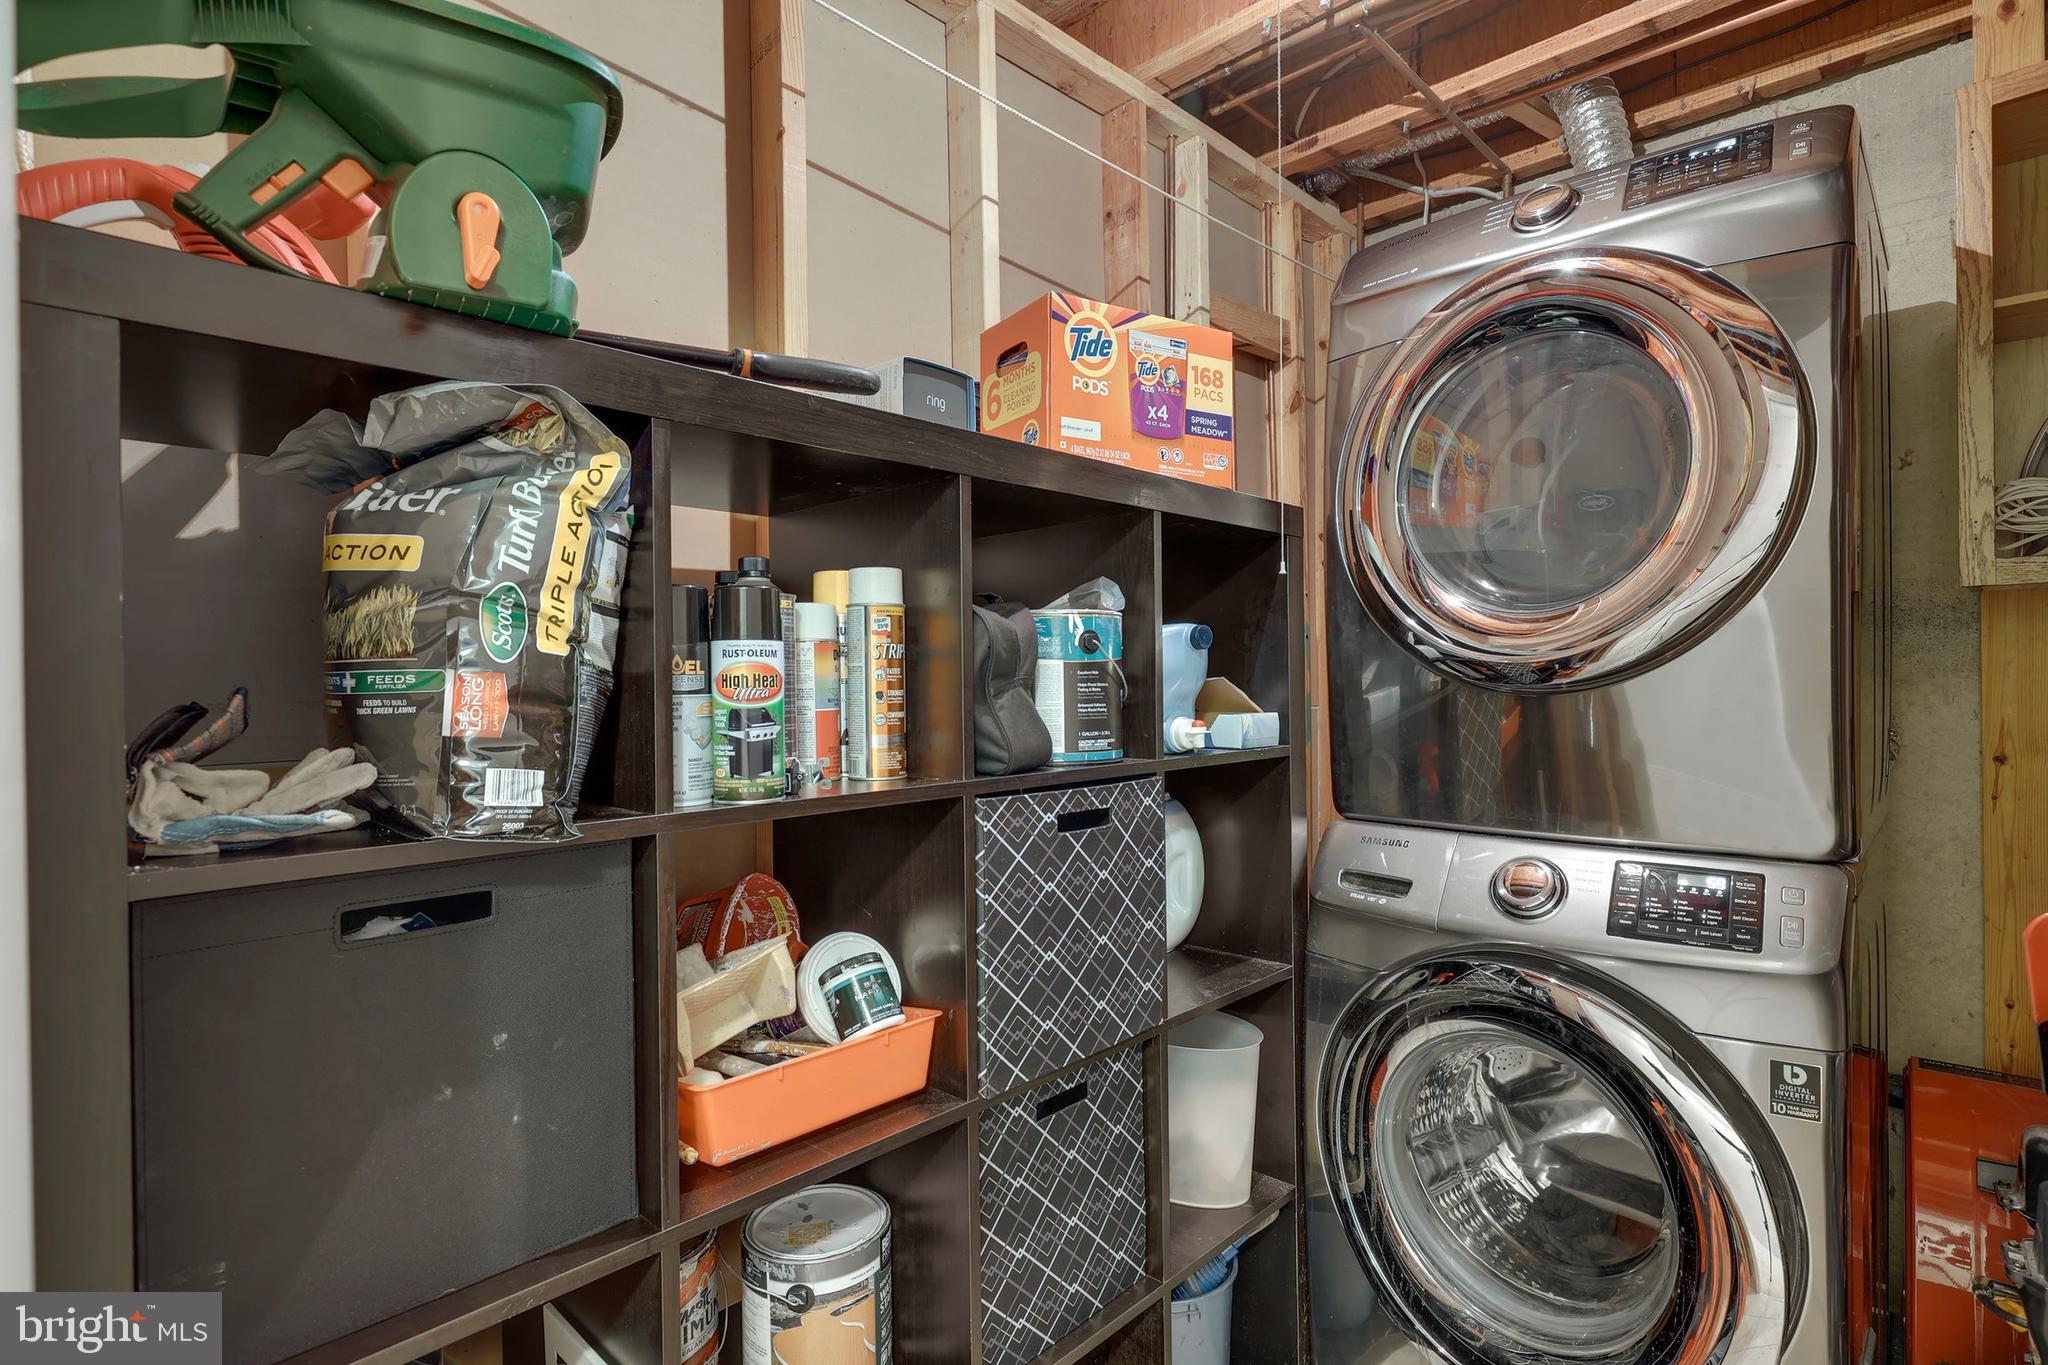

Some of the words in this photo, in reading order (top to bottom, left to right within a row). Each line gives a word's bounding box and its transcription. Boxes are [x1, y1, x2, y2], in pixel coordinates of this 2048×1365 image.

[1069, 326, 1113, 361] Tide
[1003, 362, 1036, 387] MONTHS
[1138, 361, 1158, 378] Tide
[1192, 365, 1224, 389] 168
[1003, 381, 1036, 404] CLEANING
[1072, 375, 1110, 397] PODS
[926, 394, 946, 412] ring
[987, 380, 1002, 421] 6
[1006, 394, 1032, 413] POWER!
[1194, 387, 1224, 403] PACS
[1190, 416, 1218, 427] SPRING
[325, 544, 411, 561] ACTION
[545, 546, 576, 642] TRIPLE
[722, 649, 778, 659] RUST-OLEUM
[367, 674, 416, 684] FEEDS
[721, 673, 749, 690] High
[756, 673, 779, 689] Heat
[493, 679, 502, 705] FOOD
[733, 687, 770, 701] Ultra
[363, 699, 382, 707] FEEDS
[383, 699, 391, 707] TO
[373, 707, 393, 715] GREEN
[394, 706, 417, 714] LAWNS
[469, 677, 485, 731] LONG
[1360, 836, 1410, 848] SAMSUNG
[1775, 1089, 1816, 1101] INVERTER
[1779, 1083, 1811, 1095] DIGITAL
[1771, 1102, 1787, 1114] 10
[1786, 1109, 1819, 1119] WARRANTY
